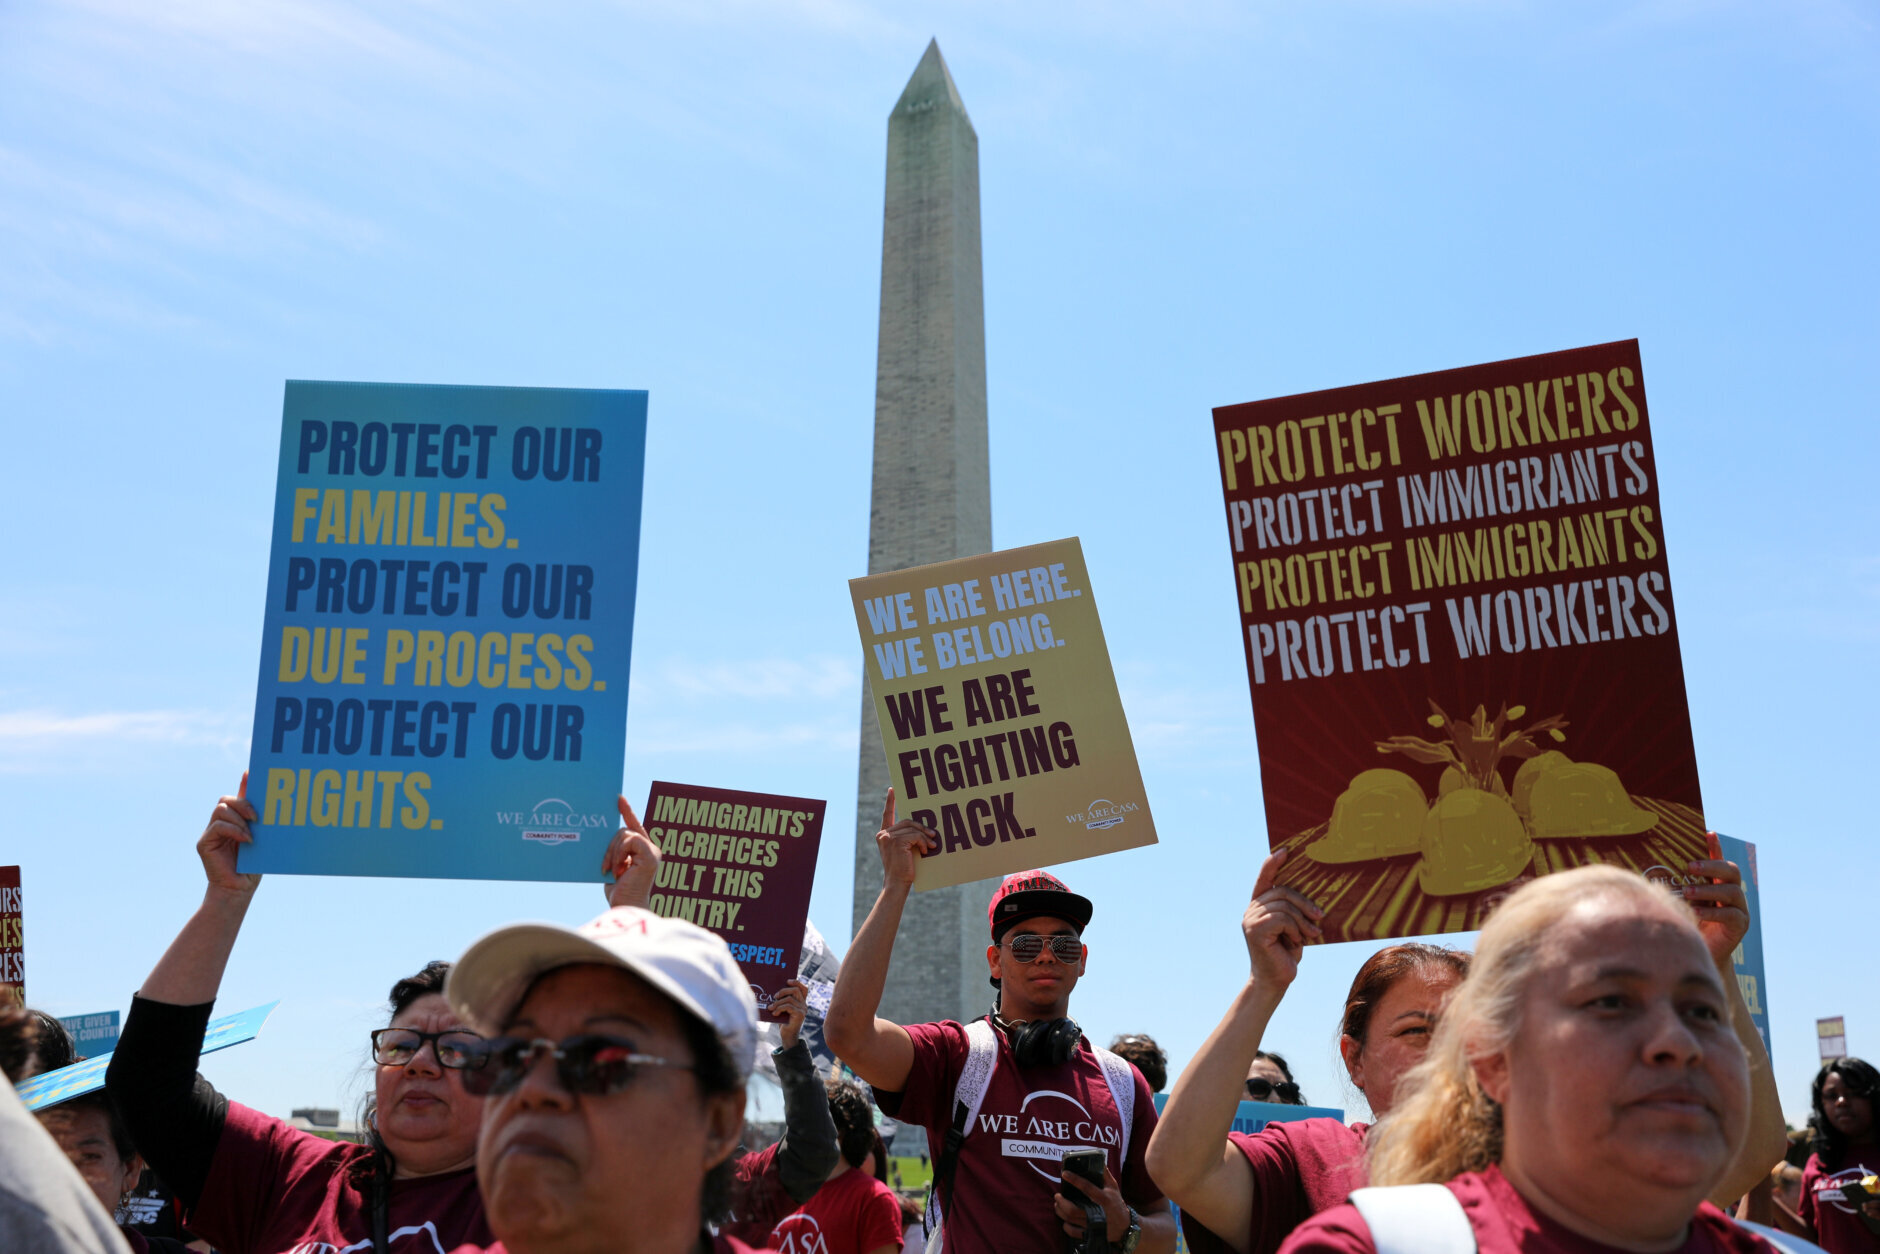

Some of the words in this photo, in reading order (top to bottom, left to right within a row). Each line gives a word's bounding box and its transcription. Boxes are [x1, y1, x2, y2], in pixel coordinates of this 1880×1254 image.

[297, 420, 497, 479] PROTECT
[511, 426, 603, 482] OUR
[1220, 404, 1402, 491] PROTECT
[1416, 367, 1640, 460] WORKERS
[291, 488, 519, 549] FAMILIES.
[1229, 479, 1384, 552] PROTECT
[1397, 440, 1649, 529] IMMIGRANTS
[284, 556, 487, 617] PROTECT
[501, 563, 594, 620] OUR
[1238, 541, 1393, 613] PROTECT
[1405, 505, 1657, 591] IMMIGRANTS
[864, 592, 918, 635] WE
[924, 579, 986, 625] ARE
[990, 563, 1082, 612] HERE.
[1248, 601, 1431, 684] PROTECT
[1444, 571, 1670, 659] WORKERS
[277, 626, 369, 685] DUE
[383, 629, 606, 691] PROCESS.
[873, 634, 928, 680] WE
[933, 613, 1066, 670] BELONG.
[270, 696, 476, 758] PROTECT
[490, 703, 585, 762] OUR
[884, 685, 953, 740] WE
[961, 668, 1041, 727] ARE
[898, 721, 1081, 800] FIGHTING
[262, 767, 443, 830] RIGHTS.
[496, 811, 523, 825] WE
[528, 812, 562, 826] ARE
[566, 813, 608, 828] CASA
[1065, 812, 1084, 824] WE
[1087, 808, 1109, 820] ARE
[1111, 802, 1139, 815] CASA
[649, 827, 780, 867] SACRIFICES
[655, 860, 706, 893] UILT
[712, 867, 764, 899] THIS
[650, 893, 745, 931] OUNTRY.
[727, 942, 787, 969] ESPECT,
[85, 1014, 111, 1028] GIVEN
[978, 1114, 1018, 1133] WE
[1025, 1117, 1070, 1140] ARE
[1074, 1121, 1121, 1149] CASA
[1009, 1143, 1065, 1157] COMMUNIT
